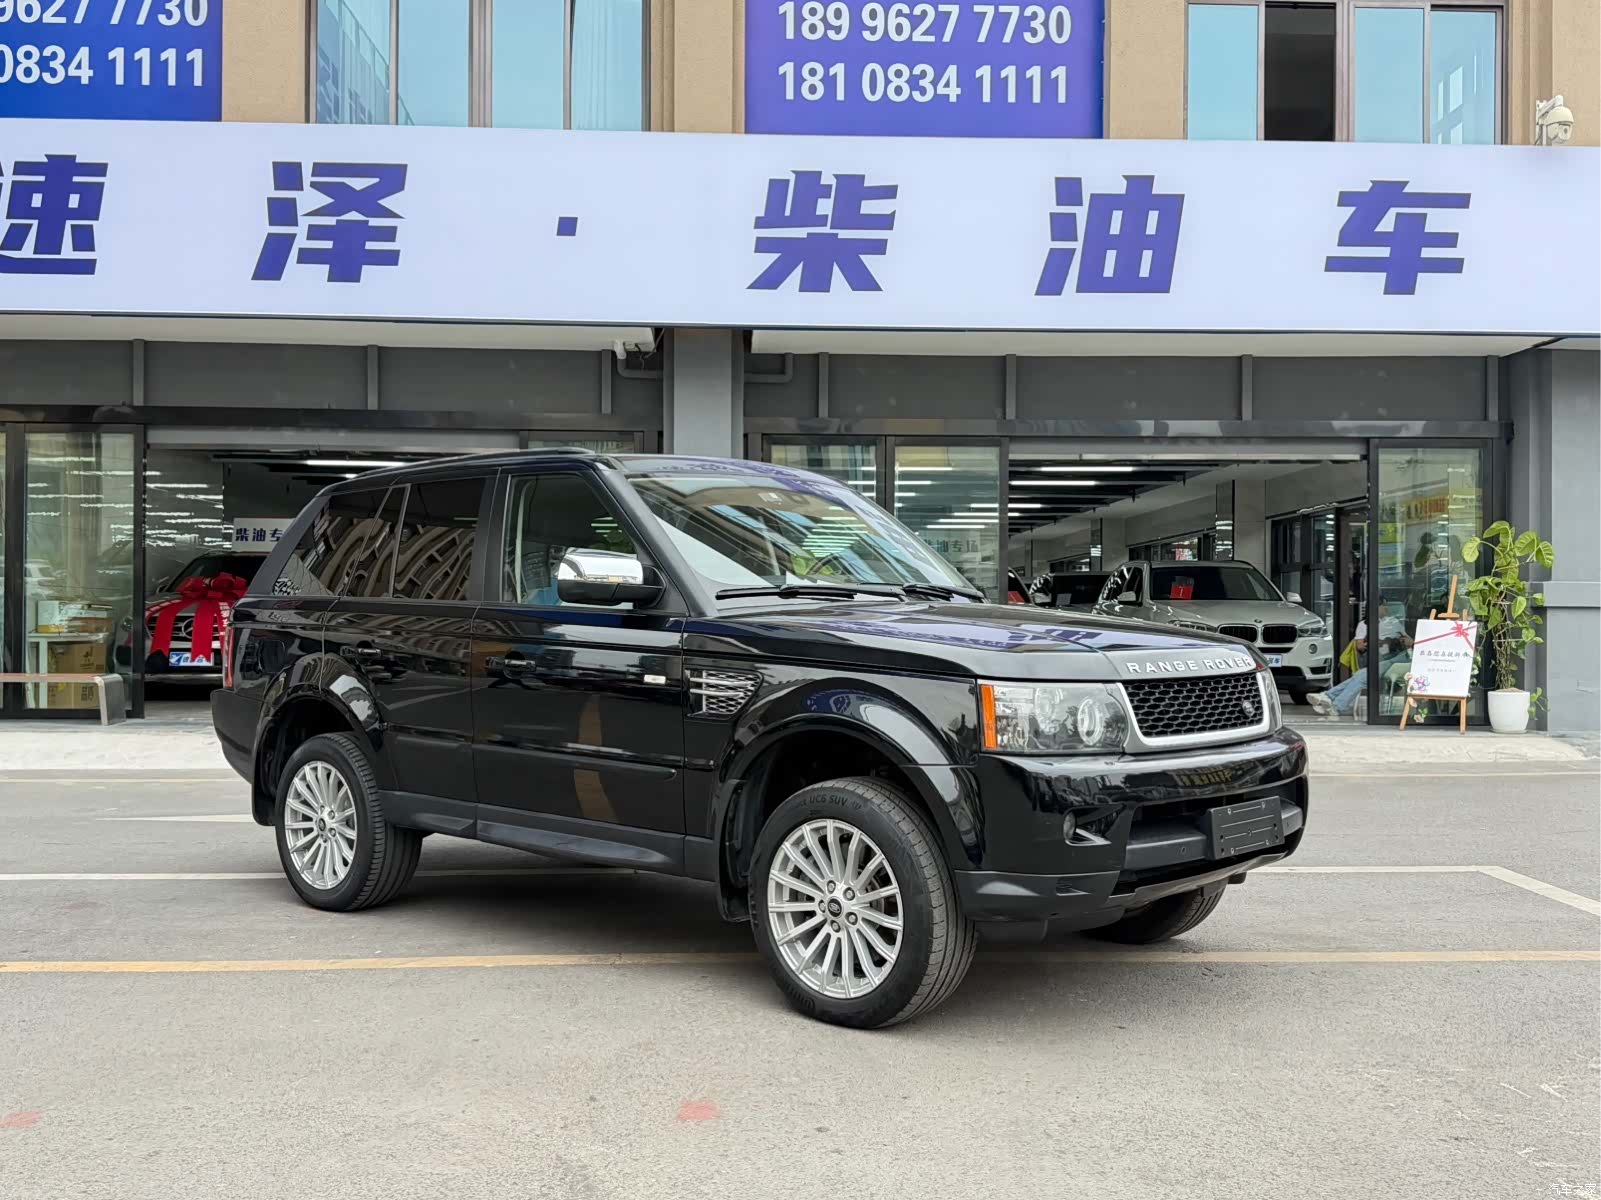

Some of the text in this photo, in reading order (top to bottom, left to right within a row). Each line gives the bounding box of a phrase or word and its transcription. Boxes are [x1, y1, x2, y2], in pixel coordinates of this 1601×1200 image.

[109, 0, 208, 26] 7730
[778, 1, 1072, 44] 189 9627 7730
[108, 47, 203, 87] 1111
[778, 62, 1067, 104] 181 0834 1111
[1126, 660, 1199, 673] RANGE
[1203, 657, 1252, 670] ROVER
[829, 794, 848, 806] SUV
